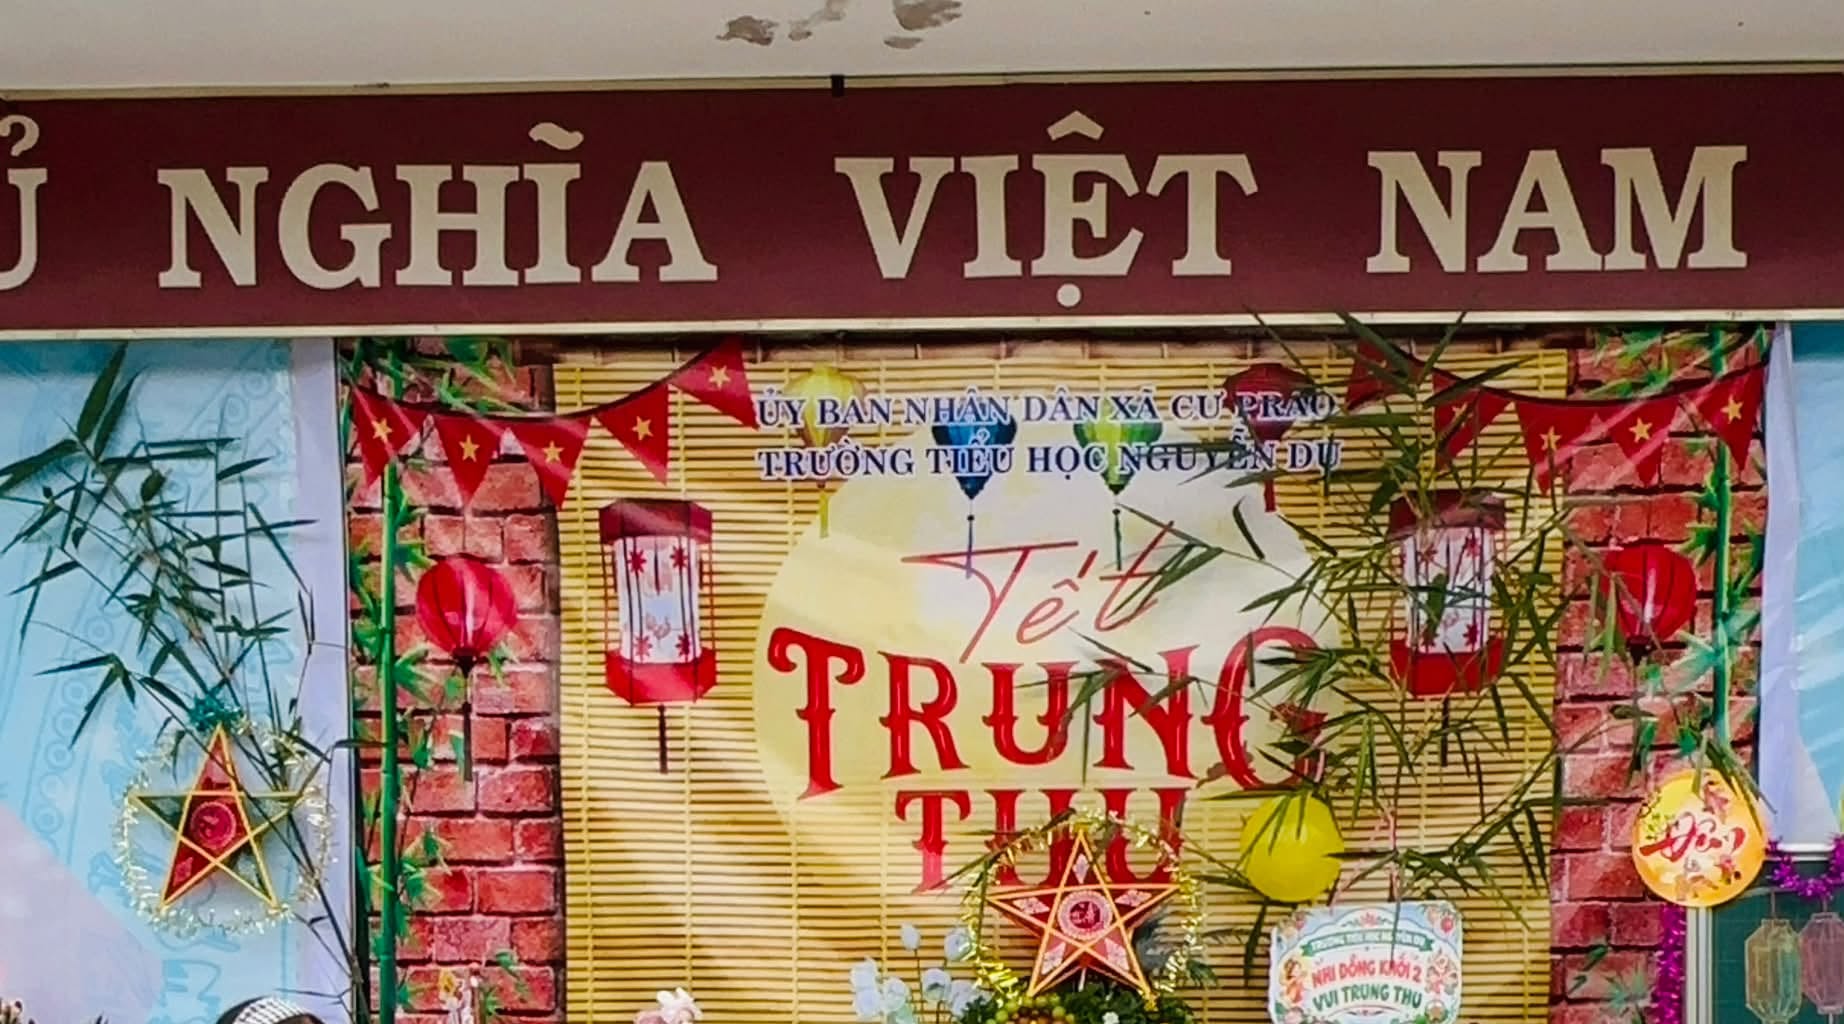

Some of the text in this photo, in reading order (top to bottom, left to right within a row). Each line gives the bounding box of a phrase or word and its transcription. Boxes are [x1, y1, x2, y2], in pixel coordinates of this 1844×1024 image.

[157, 121, 718, 290] NGHĨA
[834, 110, 1258, 308] VIỆT
[1366, 144, 1748, 274] NAM
[758, 387, 806, 426] ỦY
[817, 396, 893, 425] BAN
[903, 388, 1010, 425] NHÂN
[1023, 387, 1100, 421] DÂN
[1111, 387, 1160, 421] XÃ
[758, 438, 914, 477] TRƯỜNG
[925, 428, 1016, 475] TIỂU
[1026, 445, 1105, 480] HỌC
[900, 520, 1174, 664] Tết
[1311, 964, 1337, 988] NHI
[1412, 965, 1423, 983] 2
[1312, 983, 1422, 1012] VUI TRUNG THU
